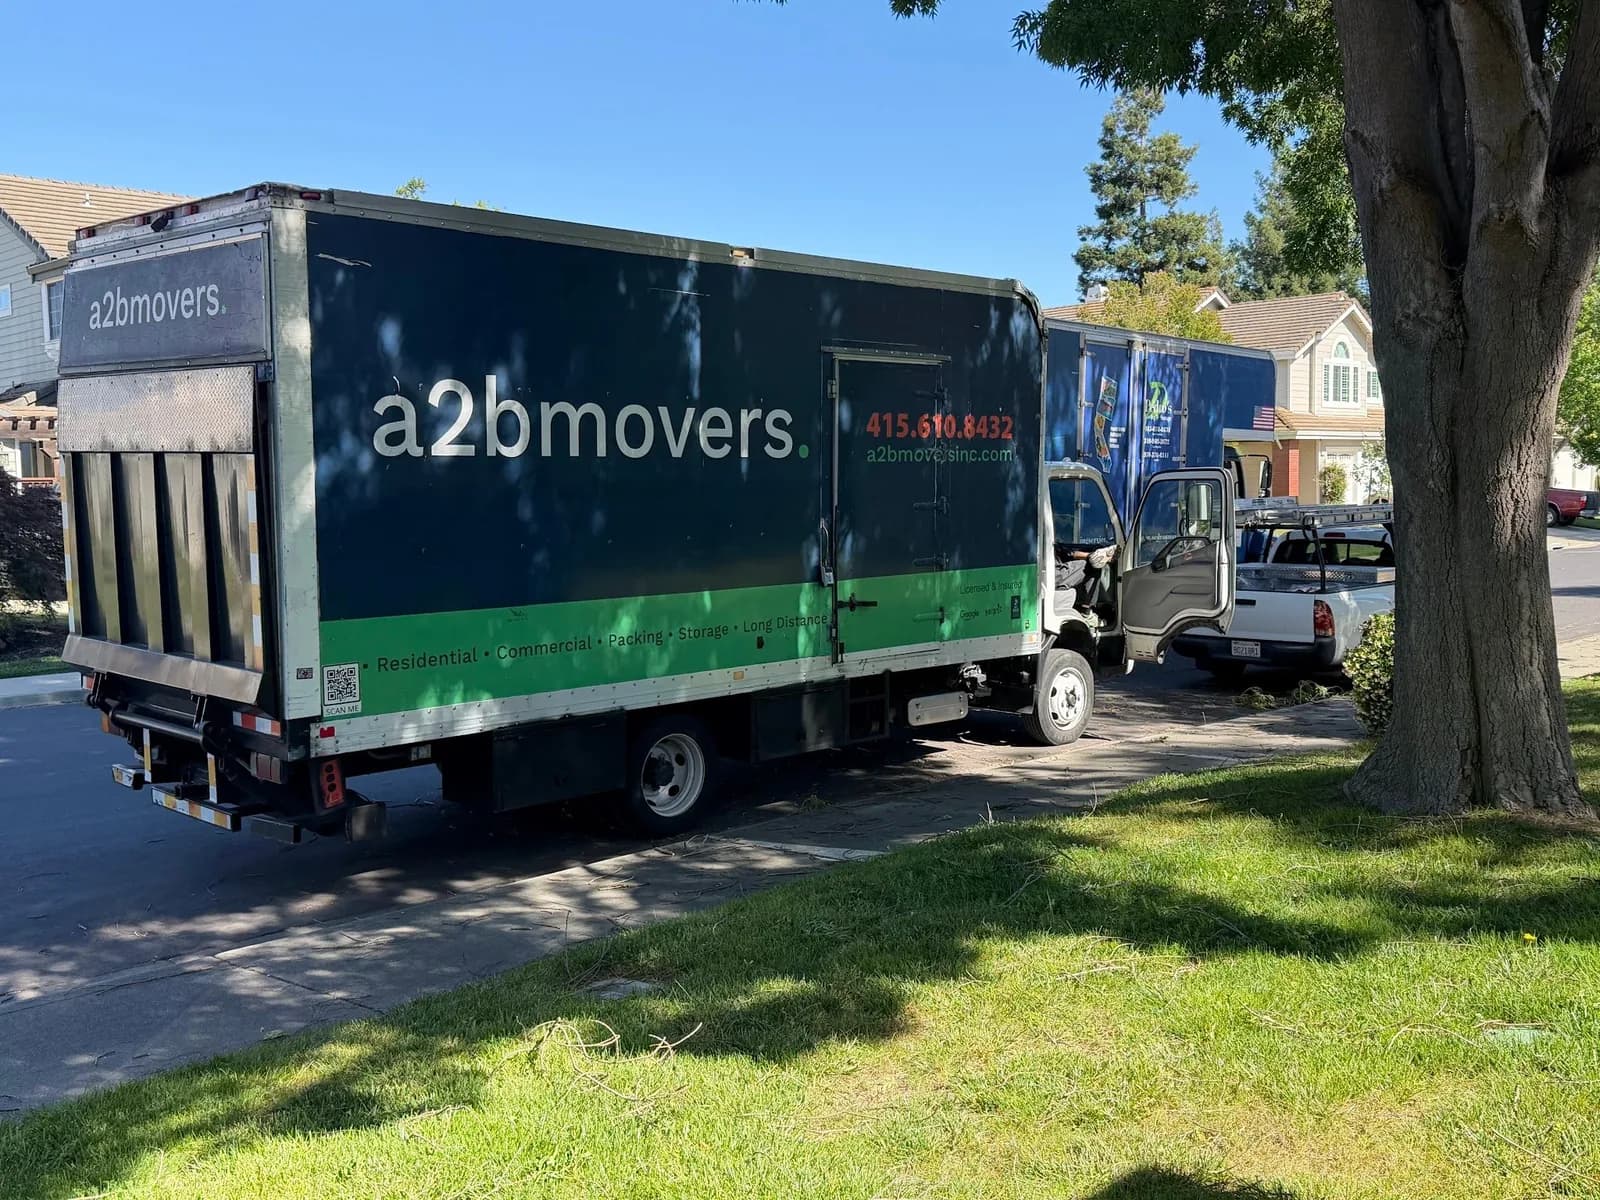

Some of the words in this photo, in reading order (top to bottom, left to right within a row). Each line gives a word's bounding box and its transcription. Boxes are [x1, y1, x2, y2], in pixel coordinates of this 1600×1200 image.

[89, 283, 227, 330] a2bmovers.
[372, 374, 809, 459] a2bmovers.
[866, 412, 1014, 440] 415.610.8432
[377, 647, 478, 672] Residential
[496, 634, 592, 660] Commercial
[609, 628, 663, 648] Packing
[679, 623, 729, 641] Storage
[743, 618, 773, 634] Long
[776, 614, 828, 630] Distance
[326, 706, 346, 715] SCAN
[347, 704, 359, 713] ME
